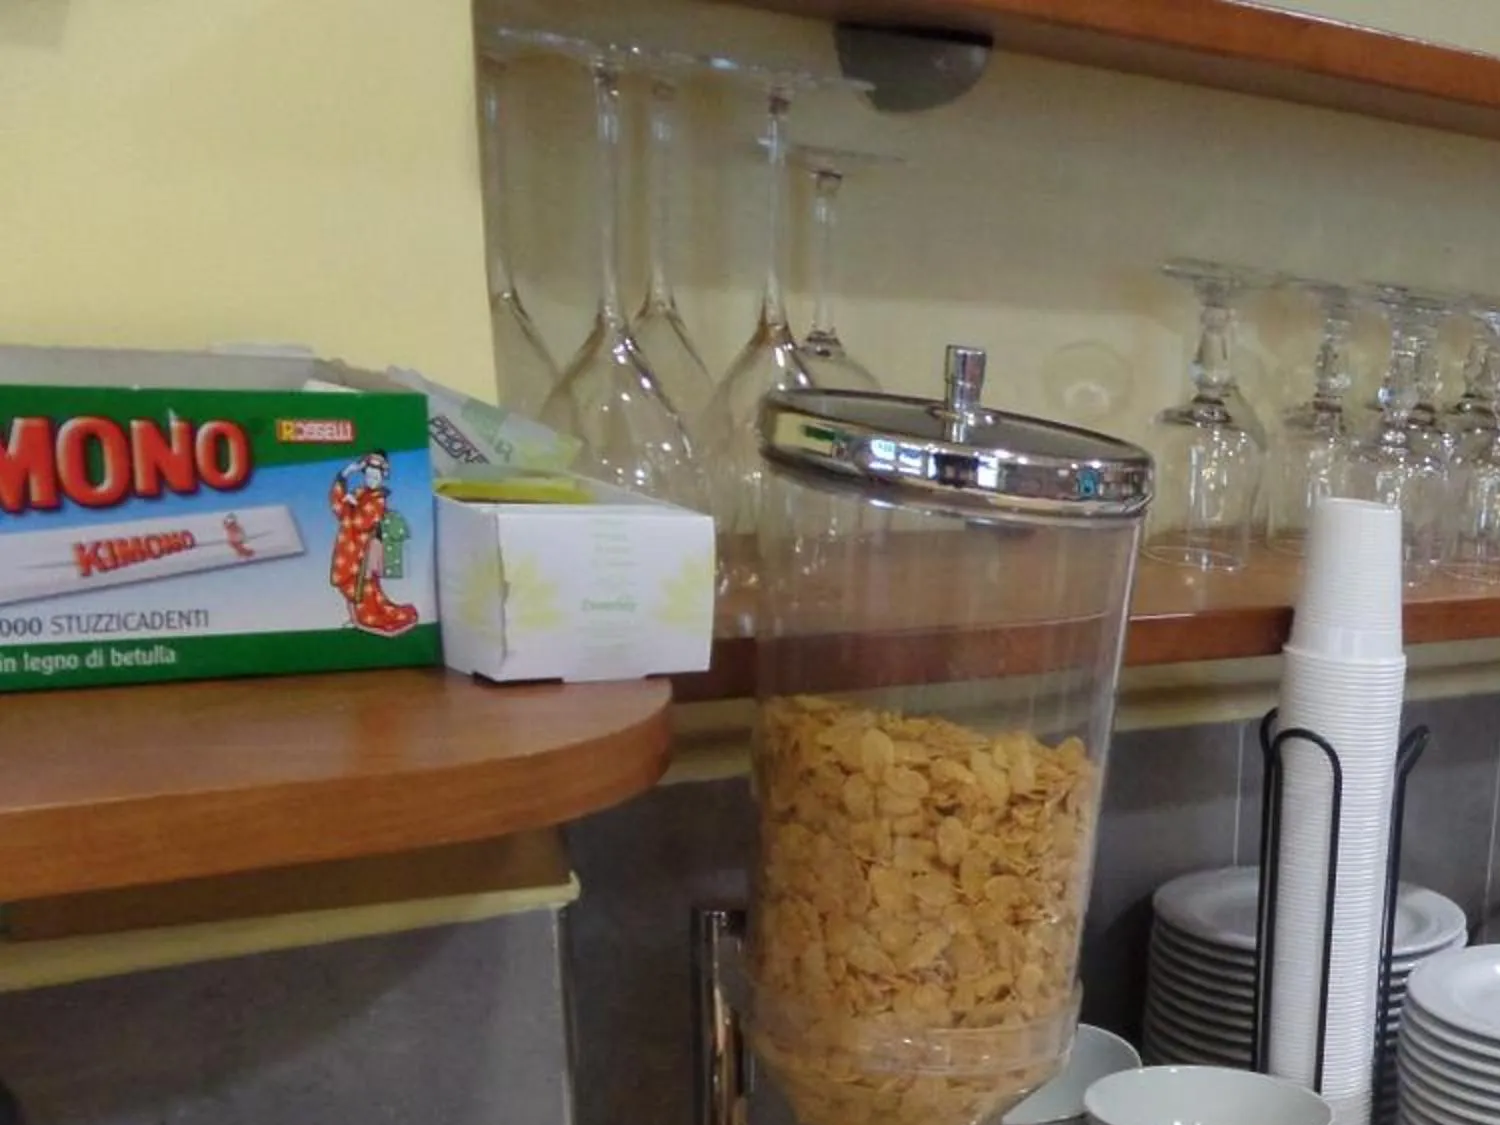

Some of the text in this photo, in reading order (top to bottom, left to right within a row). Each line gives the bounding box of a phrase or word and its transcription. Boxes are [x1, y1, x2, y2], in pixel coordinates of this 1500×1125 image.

[74, 530, 195, 577] KIMONO
[51, 609, 210, 635] STUZZICADENTI
[0, 645, 177, 676] in legno di betulla
